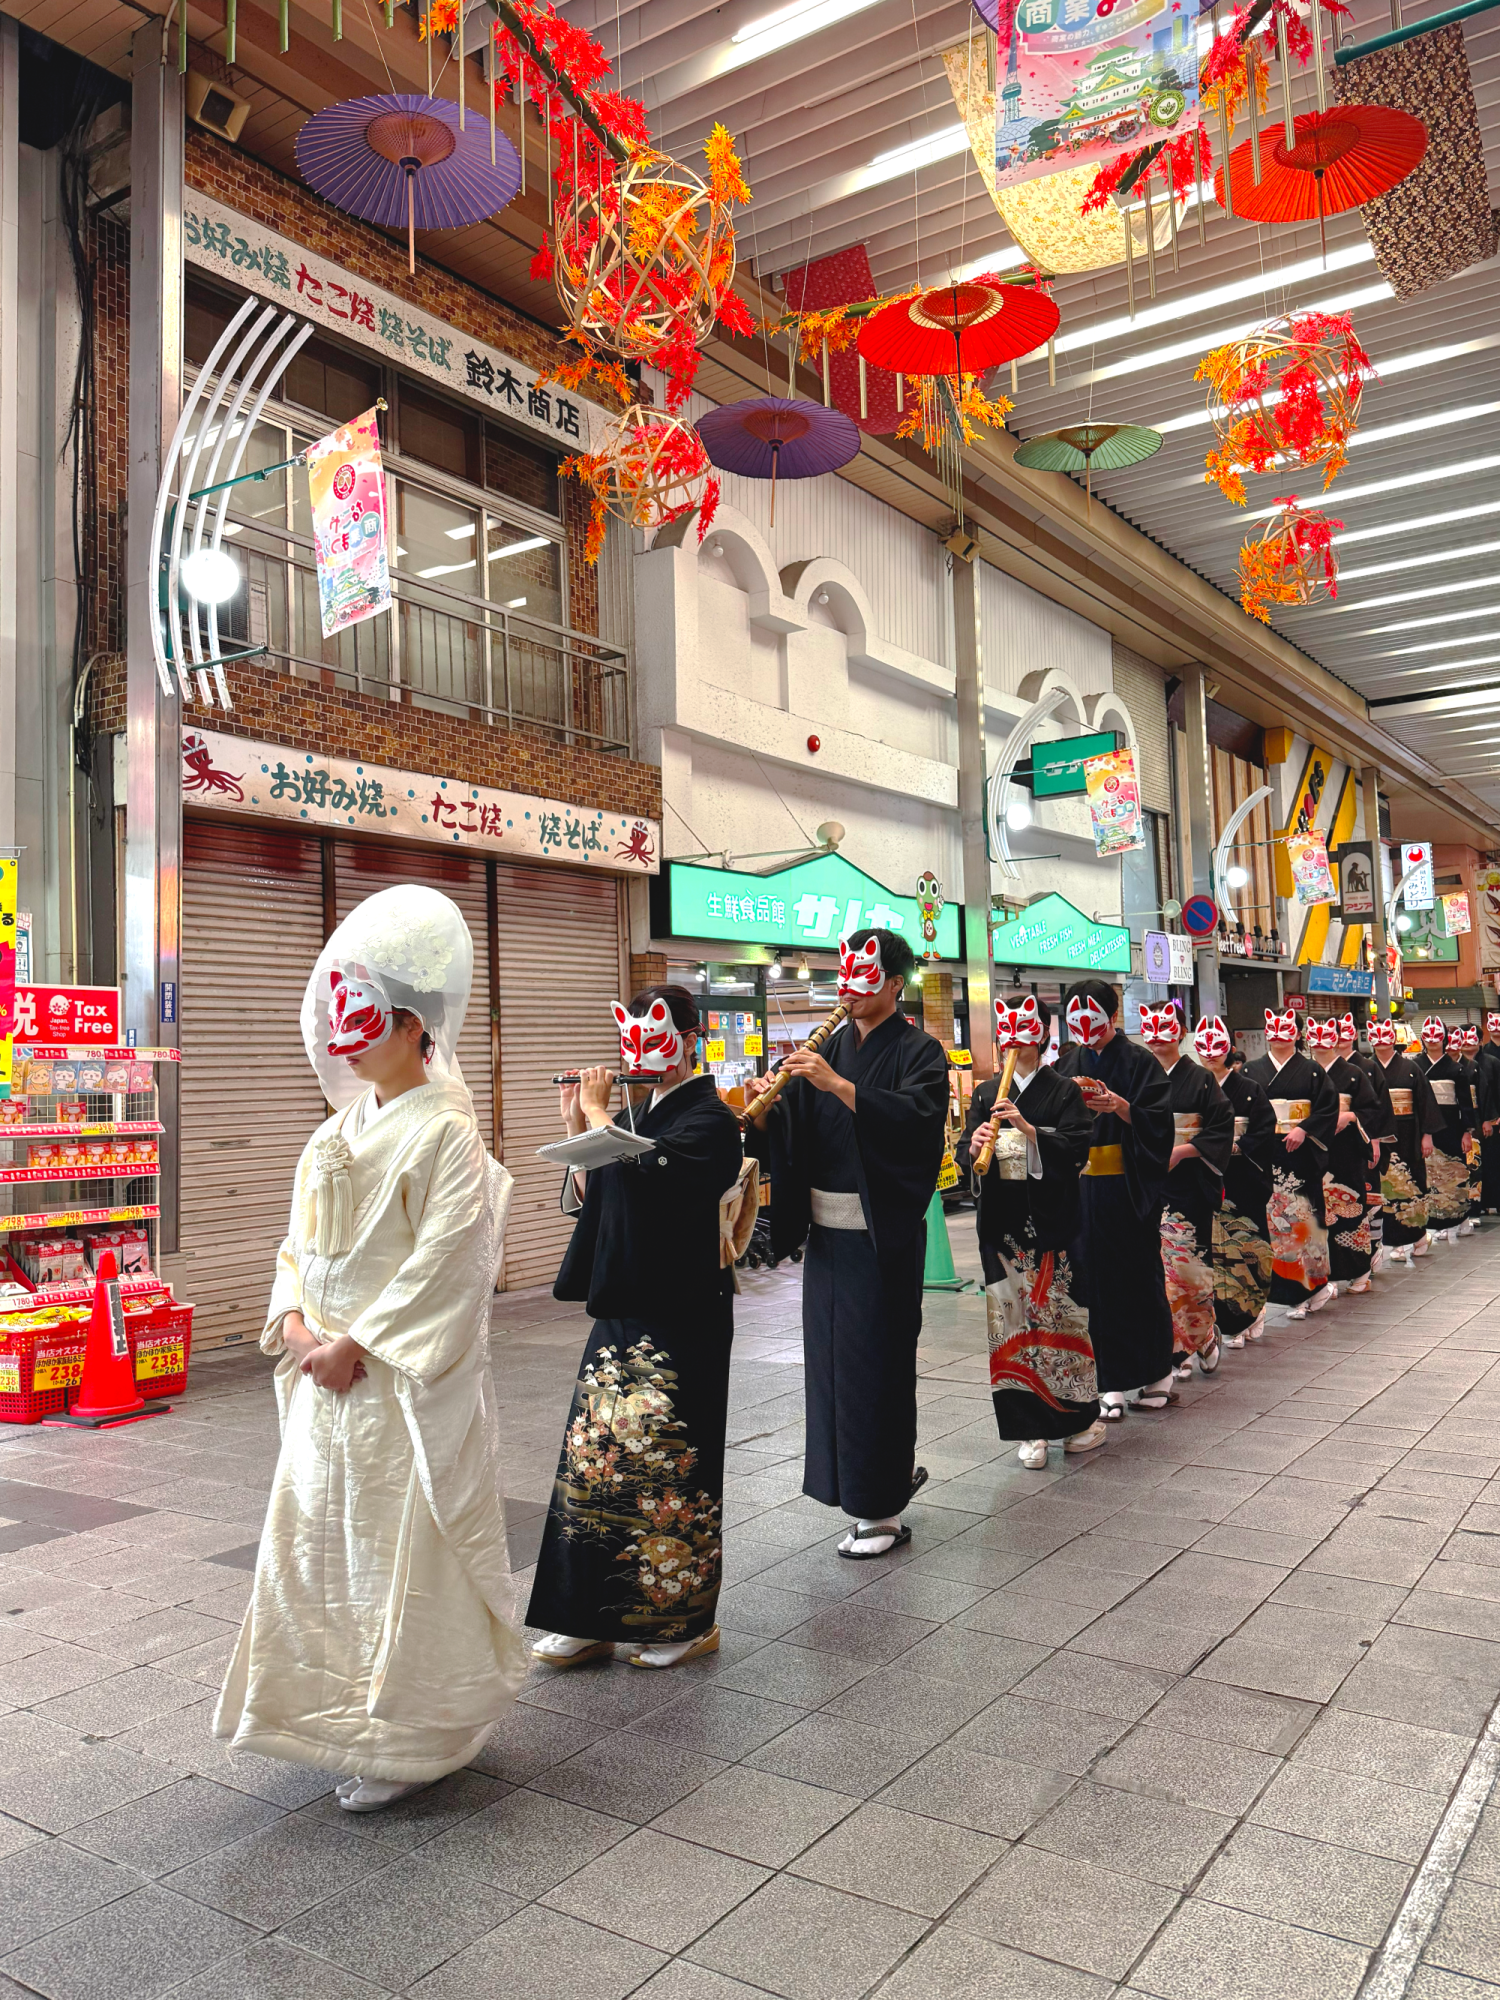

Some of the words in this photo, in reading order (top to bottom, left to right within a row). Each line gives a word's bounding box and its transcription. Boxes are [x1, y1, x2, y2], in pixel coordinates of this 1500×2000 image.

[295, 263, 376, 332] たこ焼
[379, 307, 453, 371] 焼そば
[464, 349, 580, 439] 鈴木商店
[270, 762, 388, 818] お好み焼
[431, 792, 503, 837] たこ焼
[538, 812, 602, 851] 焼そば
[707, 889, 786, 929] 生鮮食品館
[1344, 902, 1372, 911] アジア
[1010, 921, 1046, 949] VEGETABLE
[1039, 935, 1059, 954] FRESH
[1059, 926, 1073, 943] FISH
[1067, 941, 1086, 959] FRESH
[1087, 930, 1103, 948] MEAT
[1172, 938, 1191, 953] BLING
[1089, 933, 1126, 966] DELICATESSEN
[1173, 966, 1192, 980] BLING
[74, 1001, 108, 1017] Tax
[75, 1018, 113, 1034] Free
[36, 1345, 87, 1359] 当店オススメ
[136, 1334, 184, 1349] 当店オススメ
